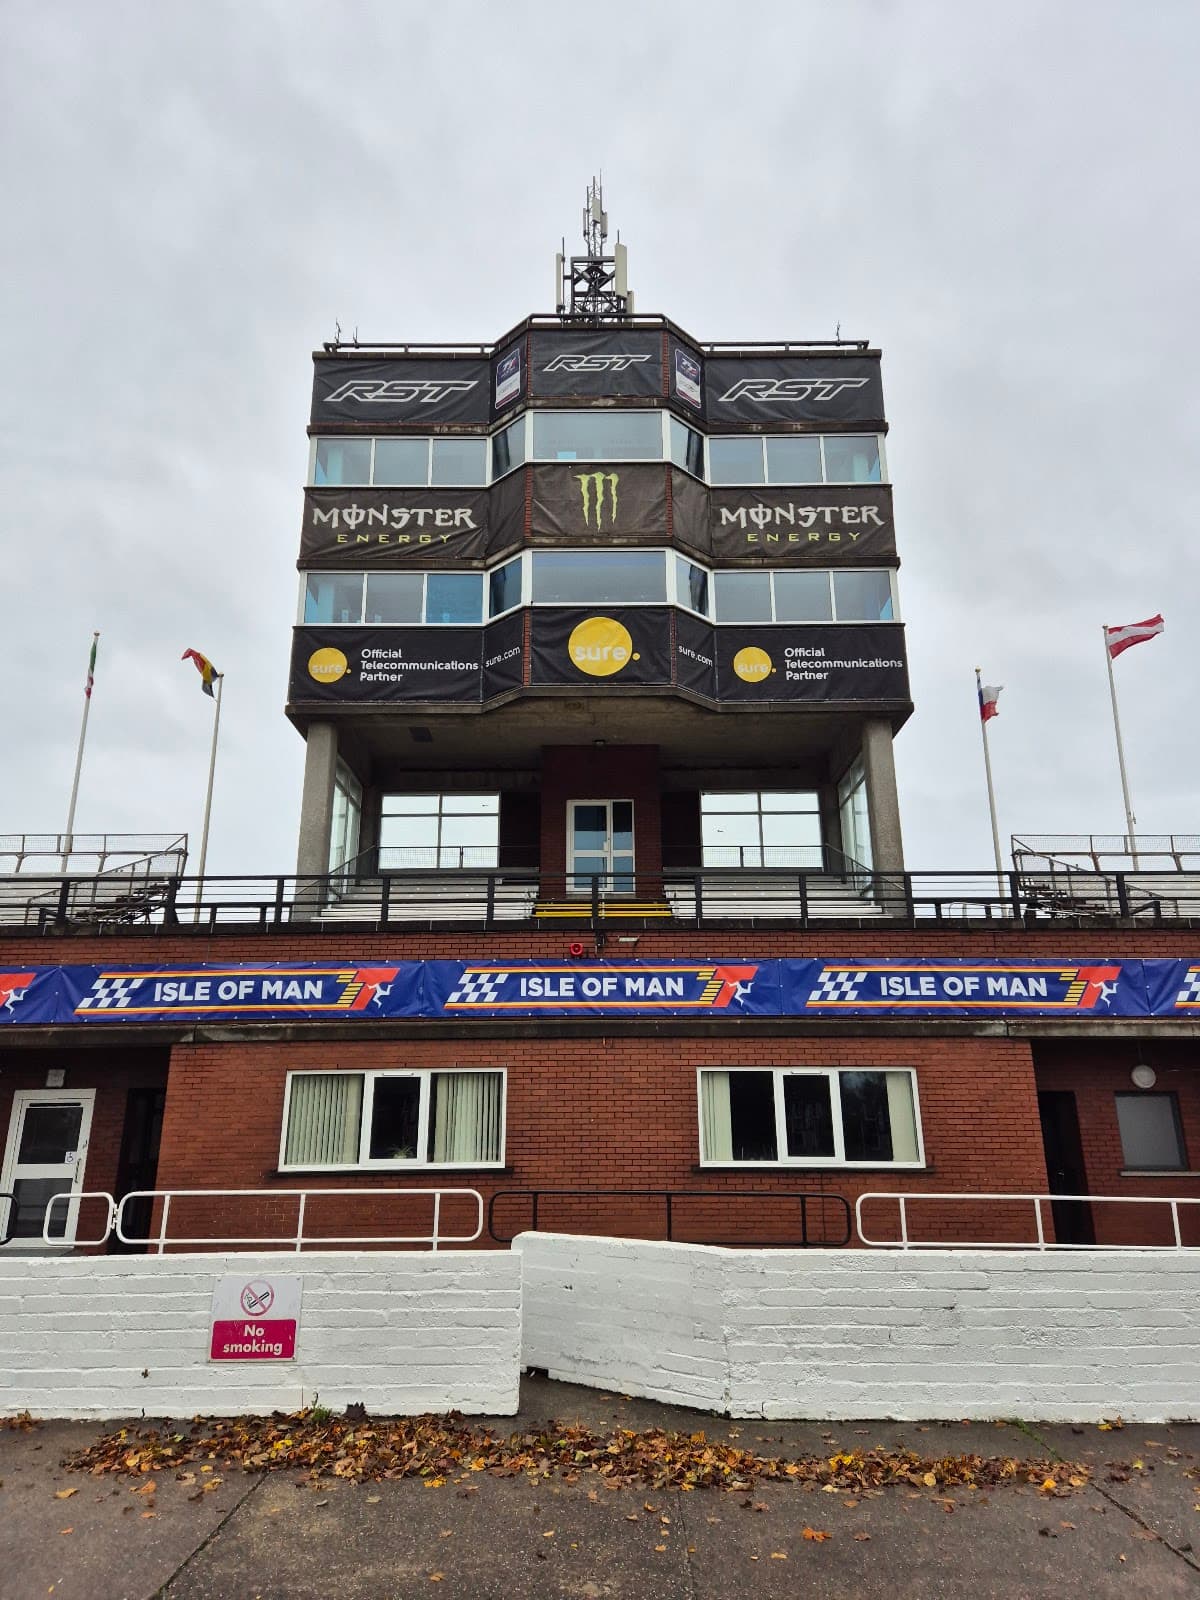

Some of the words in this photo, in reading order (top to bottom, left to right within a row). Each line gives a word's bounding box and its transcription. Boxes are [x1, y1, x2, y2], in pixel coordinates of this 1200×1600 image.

[542, 354, 652, 372] RST
[323, 380, 479, 403] RST
[717, 378, 870, 402] RST
[337, 534, 451, 543] ENERGY
[747, 532, 860, 542] ENERGY
[361, 648, 402, 659] Official
[485, 646, 521, 668] sure.com
[678, 644, 713, 667] sure.com
[784, 647, 826, 658] Official
[361, 660, 479, 671] Telecommunications
[785, 658, 903, 669] Telecommunications
[360, 672, 403, 682] Partner
[785, 670, 829, 681] Partner
[154, 981, 210, 1002] ISLE
[217, 980, 255, 1000] OF
[262, 980, 323, 1000] MAN
[520, 977, 575, 997] ISLE
[582, 977, 617, 996] OF
[625, 977, 683, 997] MAN
[880, 976, 937, 996] ISLE
[943, 976, 979, 996] OF
[987, 977, 1047, 997] MAN
[244, 1324, 265, 1337] No
[222, 1339, 283, 1356] smoking
